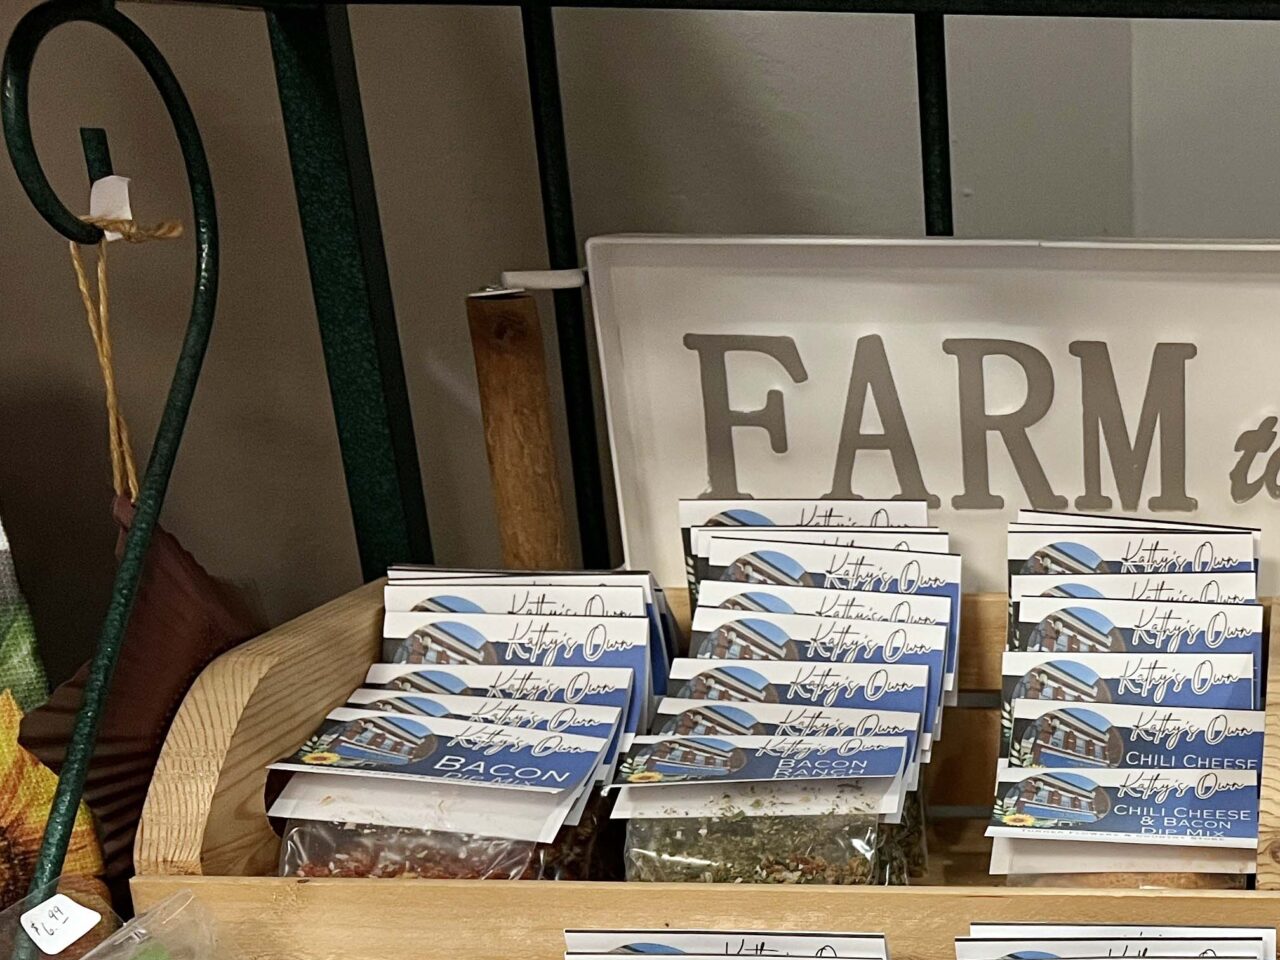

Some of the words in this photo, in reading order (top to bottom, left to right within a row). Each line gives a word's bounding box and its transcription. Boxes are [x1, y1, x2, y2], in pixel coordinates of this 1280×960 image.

[683, 333, 1198, 511] FARM
[825, 552, 894, 591] Kathy's
[898, 560, 947, 593] Own
[505, 619, 578, 666] Kathy's
[582, 624, 634, 662] Own
[806, 623, 878, 662] Kathy's
[883, 629, 931, 663] Own
[1132, 606, 1200, 652] Kathy's
[1205, 611, 1253, 648] Own
[564, 672, 616, 704] Own
[788, 665, 859, 706] Kathy's
[864, 669, 914, 701] Own
[1118, 657, 1184, 703] Kathy's
[1192, 659, 1239, 695] Own
[547, 708, 600, 732] Own
[854, 714, 905, 736] Own
[1130, 710, 1199, 750] Kathy's
[1205, 714, 1253, 746] Own
[447, 726, 524, 759] Kathy's
[532, 735, 586, 758] Own
[756, 738, 837, 757] Kathy's
[837, 738, 889, 755] Own
[434, 755, 569, 782] BACON
[778, 759, 867, 768] BACON
[1126, 751, 1175, 766] CHILI
[1183, 755, 1257, 770] CHEESE
[1118, 772, 1189, 804] Kathy's
[1196, 772, 1244, 799] Own
[1113, 805, 1165, 817] CHILI
[1173, 807, 1251, 821] CHEESE
[1140, 817, 1155, 825] &
[1163, 818, 1231, 829] BACON
[1141, 827, 1177, 836] DIP
[1186, 829, 1225, 837] MIX
